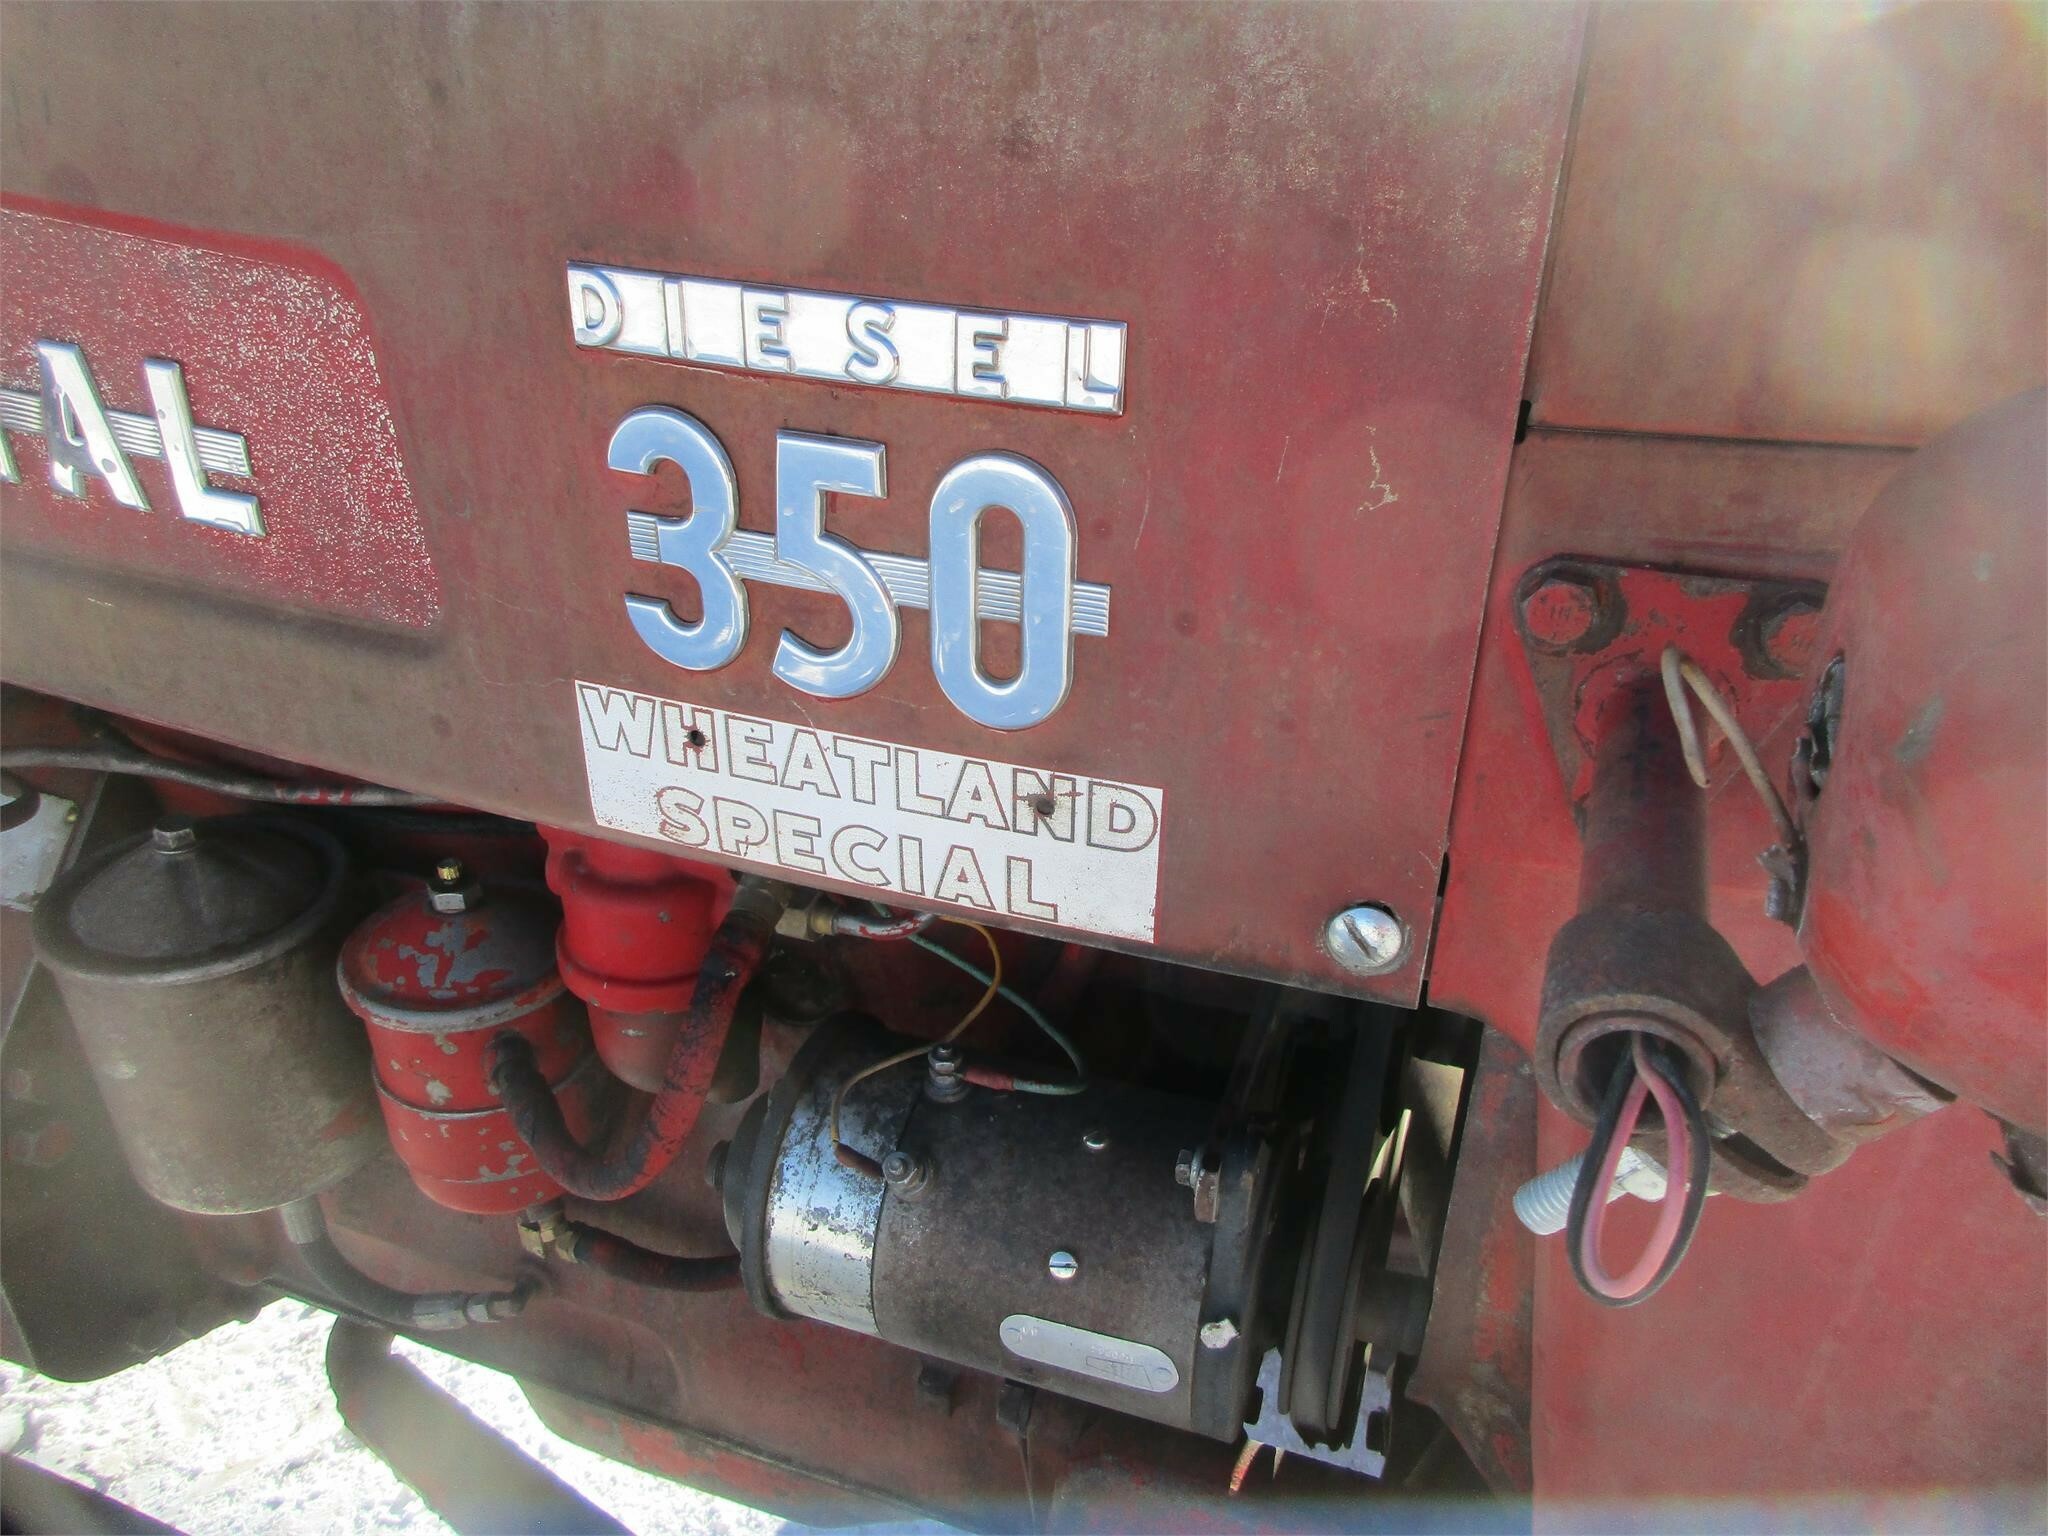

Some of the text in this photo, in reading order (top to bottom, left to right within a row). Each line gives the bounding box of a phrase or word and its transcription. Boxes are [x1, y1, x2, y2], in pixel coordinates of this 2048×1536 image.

[568, 264, 1127, 415] DIESEL
[0, 338, 267, 537] AL
[607, 403, 1078, 733] 350
[577, 685, 1159, 853] WHEATLAND
[655, 785, 1059, 922] SPECIAL
